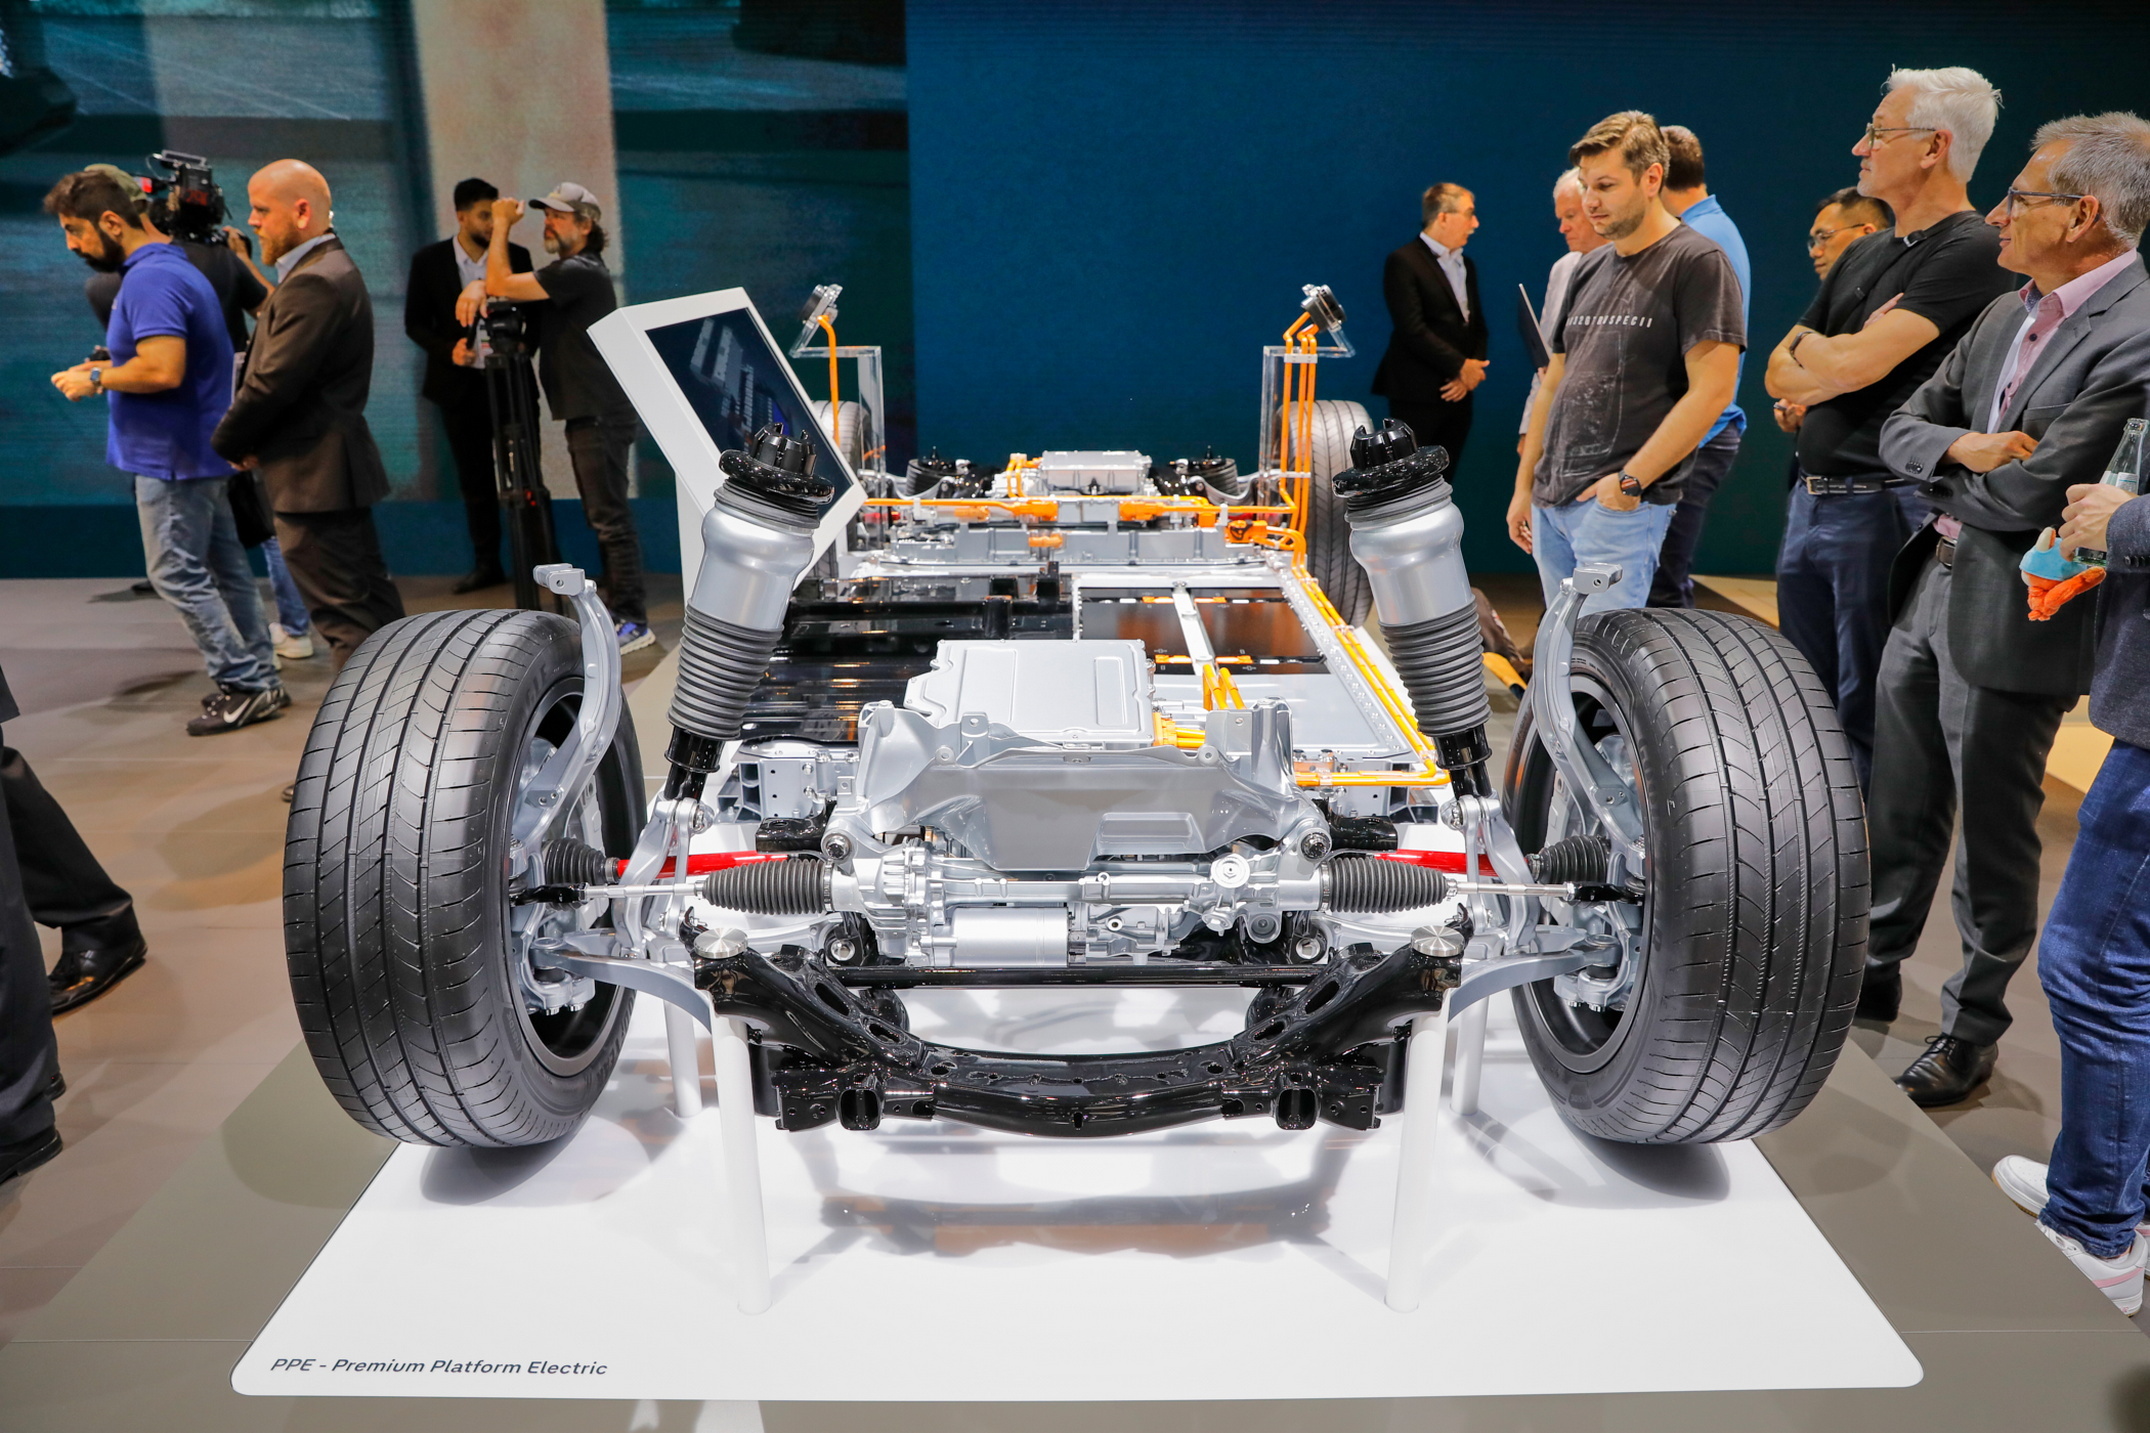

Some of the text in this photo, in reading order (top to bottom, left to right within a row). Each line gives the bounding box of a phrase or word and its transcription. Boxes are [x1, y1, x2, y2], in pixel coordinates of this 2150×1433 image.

[270, 1358, 316, 1372] PPE
[331, 1358, 425, 1373] Premium
[430, 1359, 521, 1374] Platform
[527, 1360, 608, 1376] Electric
